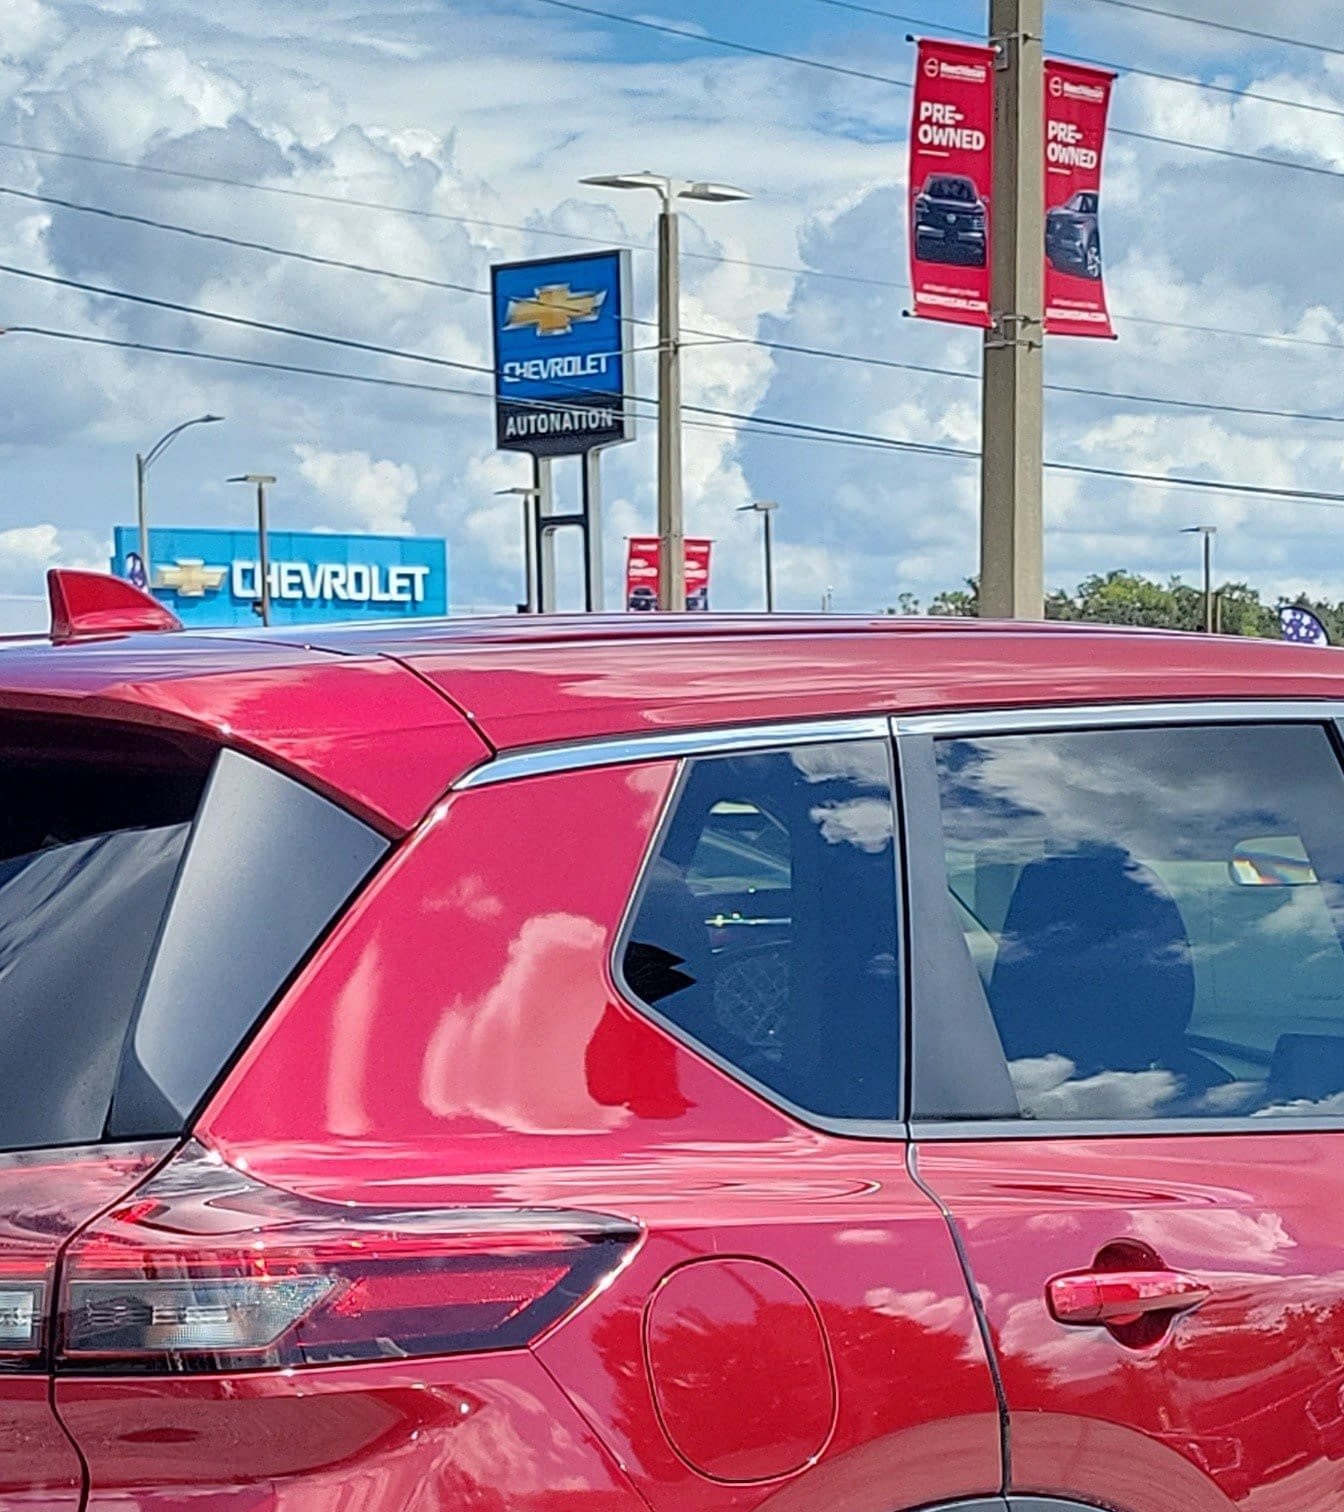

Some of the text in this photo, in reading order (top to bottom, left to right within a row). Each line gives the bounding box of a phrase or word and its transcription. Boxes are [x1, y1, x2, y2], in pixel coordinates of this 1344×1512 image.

[919, 101, 965, 126] PRE-
[918, 123, 986, 151] OWNED
[1047, 119, 1084, 145] PRE-
[1046, 141, 1098, 170] OWNED
[502, 354, 608, 382] CHEVROLET
[505, 407, 614, 437] AUTONATION
[232, 560, 430, 602] CHEVROLET
